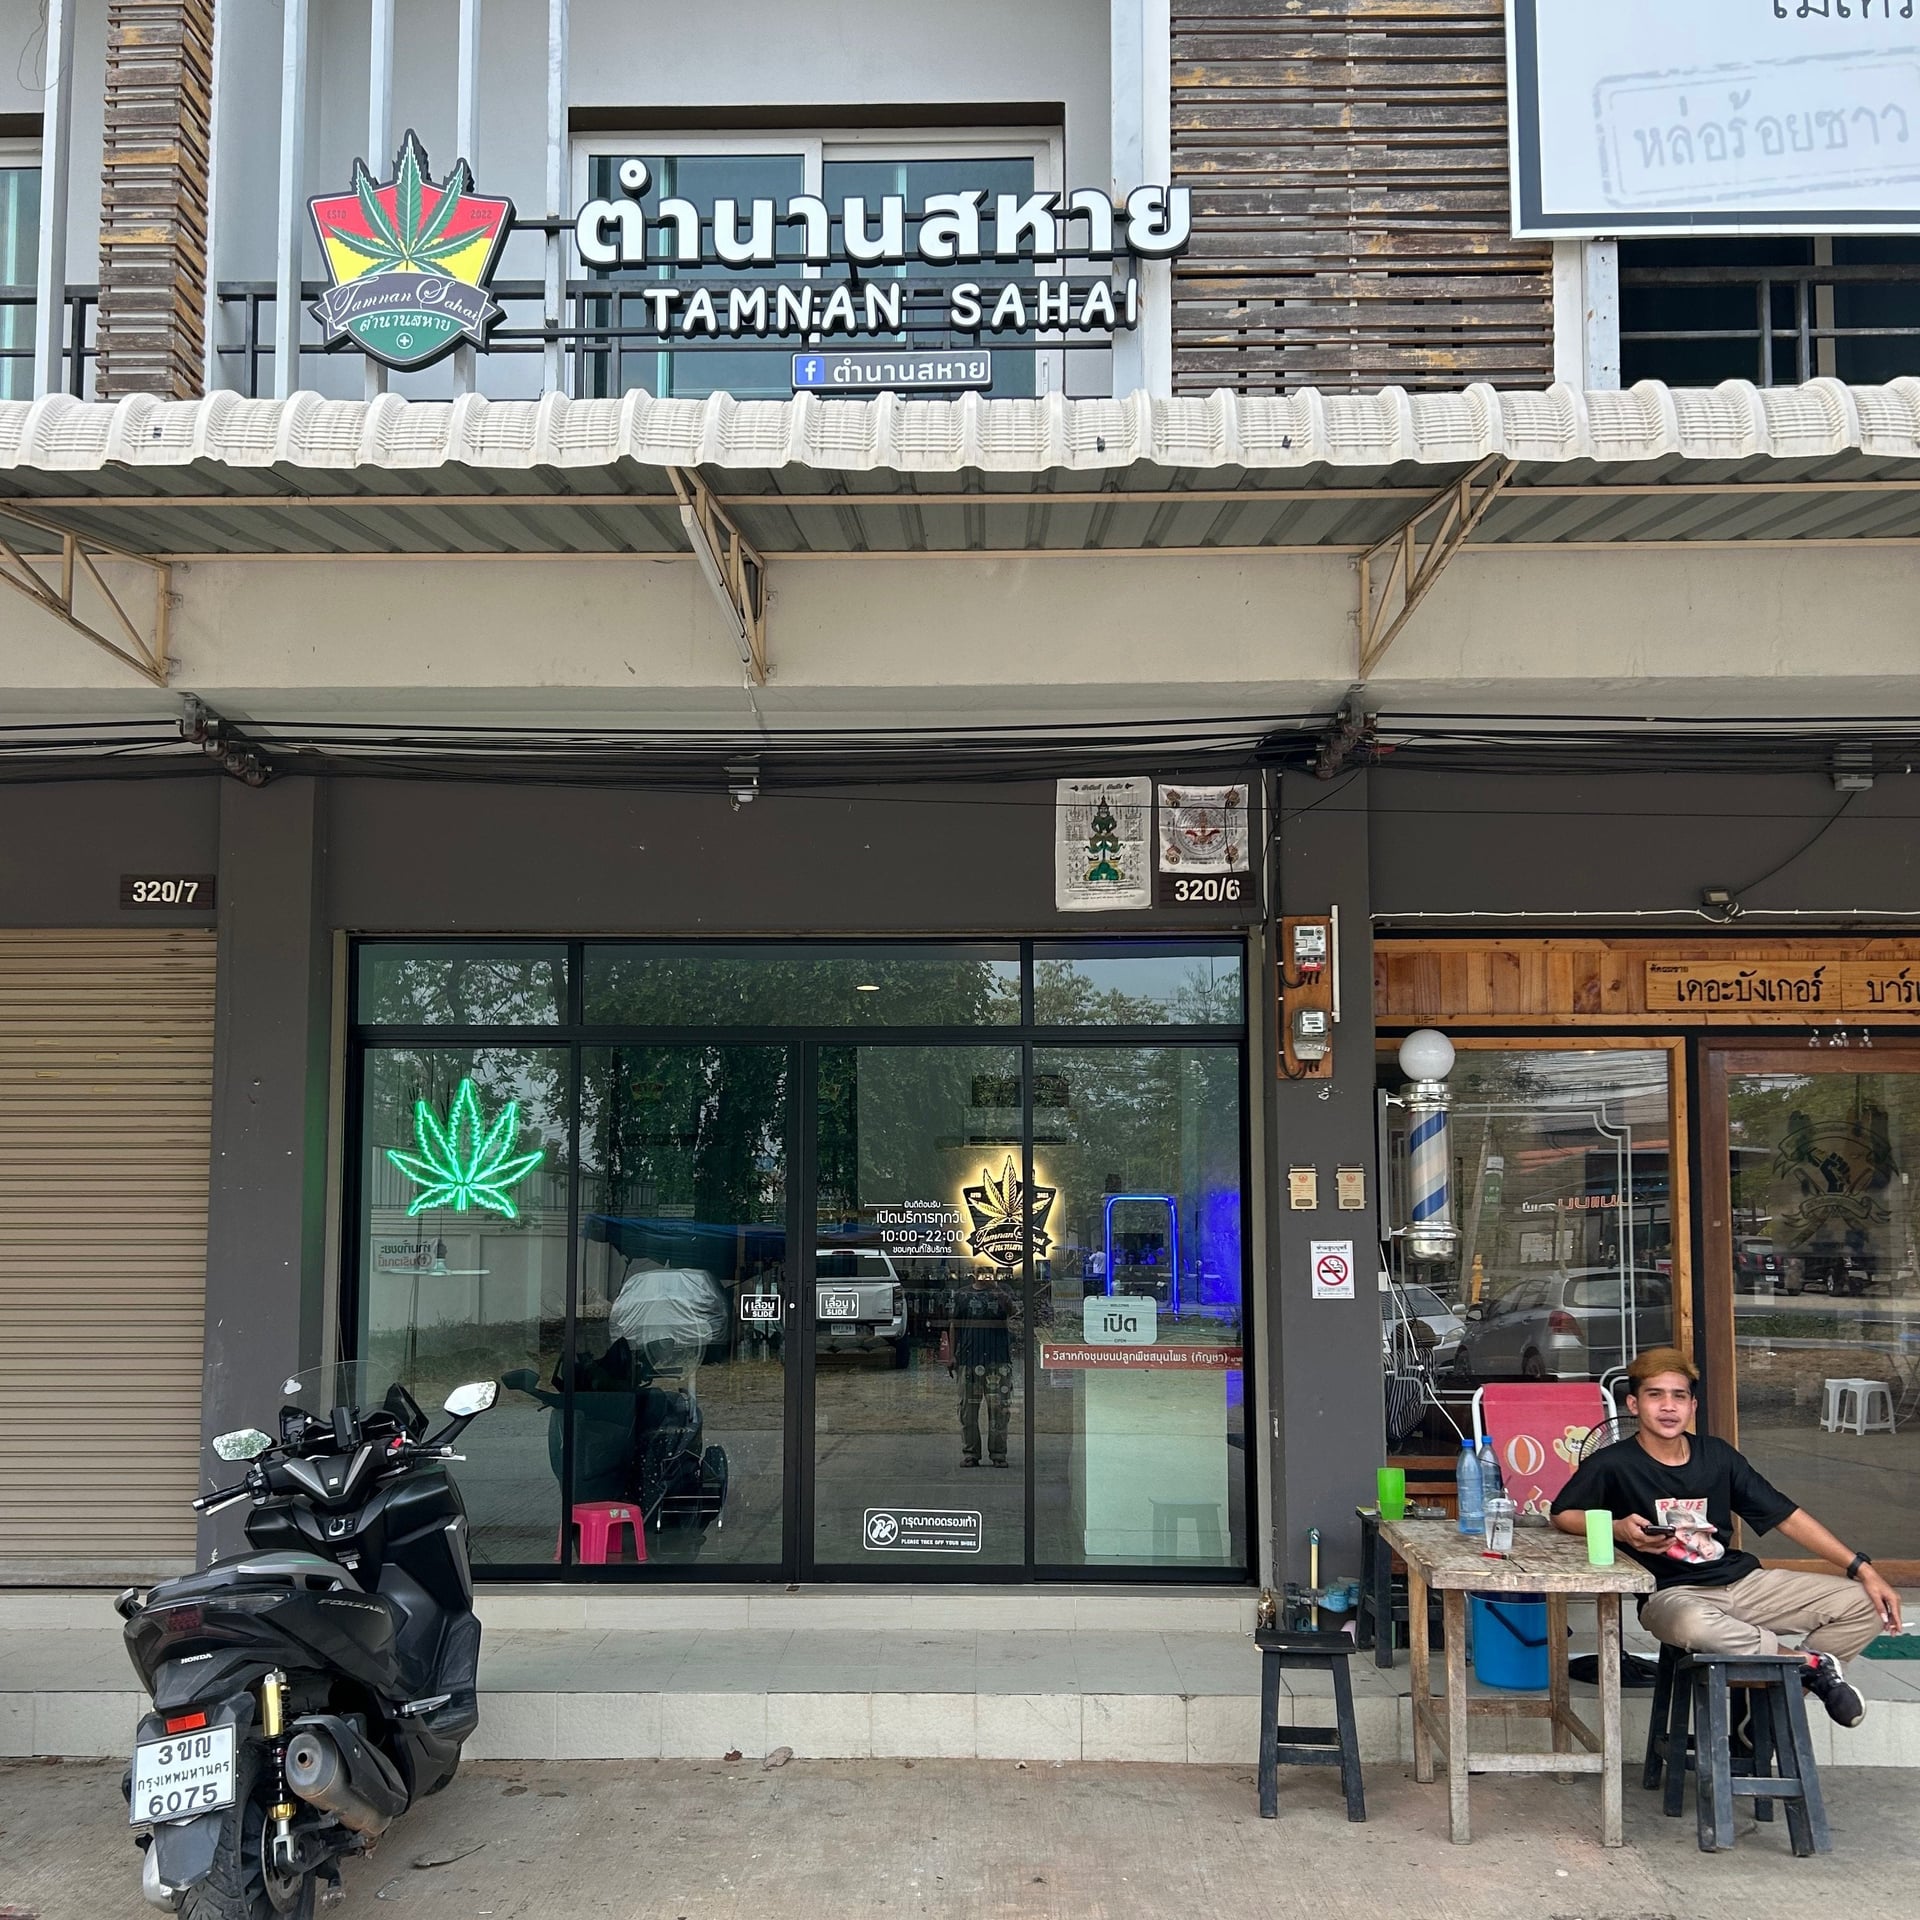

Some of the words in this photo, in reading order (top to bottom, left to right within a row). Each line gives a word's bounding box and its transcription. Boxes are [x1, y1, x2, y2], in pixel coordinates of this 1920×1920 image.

[1633, 89, 1910, 169] หล่อร้อยซาว
[470, 210, 492, 219] 2022
[577, 159, 1192, 264] ตำนานสหาย
[329, 276, 412, 324] Tamnan
[415, 278, 480, 322] Sahai
[643, 283, 902, 332] TAMNAN
[950, 278, 1138, 328] SAHAI
[359, 315, 451, 332] ตำนานสหาย
[832, 359, 986, 385] ตำนานสหาย
[132, 879, 199, 904] 320/7
[1174, 876, 1241, 902] 320/6
[1676, 966, 1827, 1003] เดอะบังเกอร์
[880, 1230, 965, 1243] 10:00-22:00
[751, 1297, 775, 1309] เลื่อน
[825, 1294, 849, 1308] เลื่อน
[826, 1308, 847, 1316] SLIDE
[1103, 1313, 1137, 1333] เปิด
[1052, 1348, 1188, 1365] วิสาหกิจชุมชนปลูกพืชสมุนไพร
[1191, 1350, 1229, 1365] (กัญชา)
[901, 1516, 976, 1528] กรุณาถอดรองเท้า
[180, 1653, 213, 1665] HONDA
[157, 1735, 212, 1766] 3ขญ
[137, 1760, 230, 1793] กรุงเทพมหานคร
[148, 1782, 218, 1817] 6075
